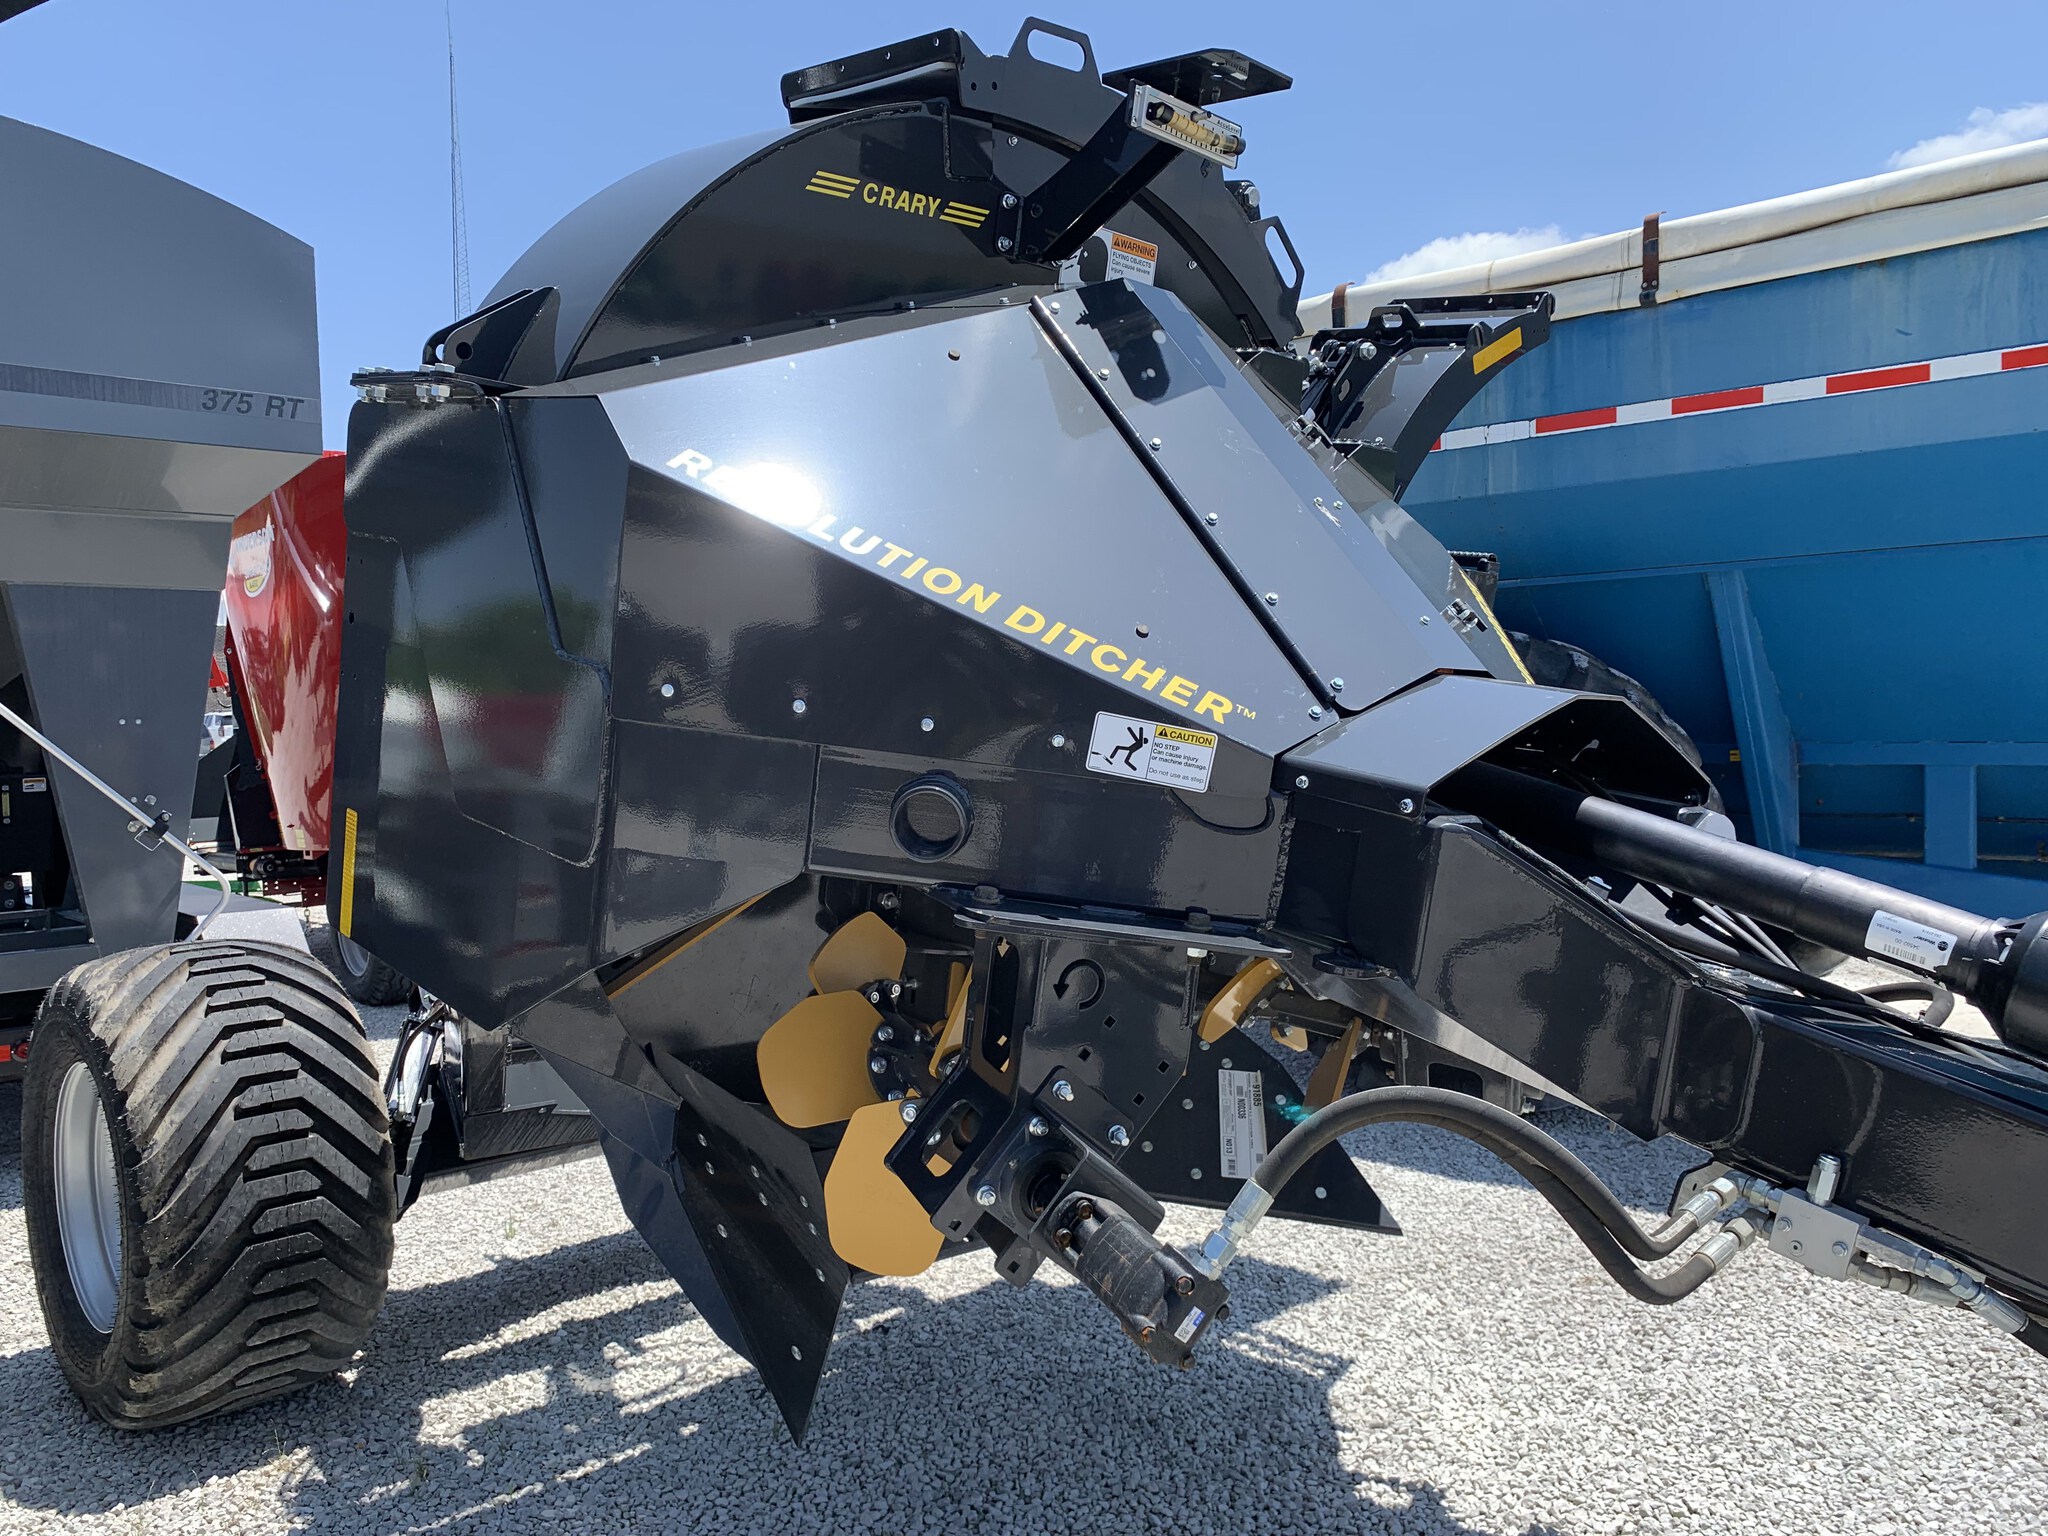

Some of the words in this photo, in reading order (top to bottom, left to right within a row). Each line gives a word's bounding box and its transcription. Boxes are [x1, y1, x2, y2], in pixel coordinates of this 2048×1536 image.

[863, 182, 941, 218] CRARY
[1120, 239, 1155, 258] WARNING
[1111, 258, 1122, 267] Can
[1122, 262, 1135, 271] cause
[1135, 266, 1150, 275] severe
[1112, 251, 1130, 262] FLYING
[1130, 255, 1152, 268] OBJECTS
[201, 389, 254, 415] 375
[264, 395, 305, 419] RT
[666, 448, 1002, 614] RLUTION
[1003, 604, 1234, 725] DITCHER
[1153, 741, 1164, 750] NO
[1164, 743, 1180, 752] STEP
[1169, 730, 1212, 746] CAUTION
[1152, 747, 1164, 756] Can
[1164, 749, 1182, 759] cause
[1182, 753, 1199, 764] injury
[1158, 756, 1182, 766] machine
[1183, 759, 1208, 771] damage.
[1148, 766, 1158, 775] Do
[1158, 768, 1169, 777] not
[1169, 772, 1181, 780] use
[1181, 774, 1190, 782] as
[1252, 1084, 1262, 1107] 91885
[1237, 1098, 1247, 1120] N00336
[1225, 1138, 1233, 1154] N013
